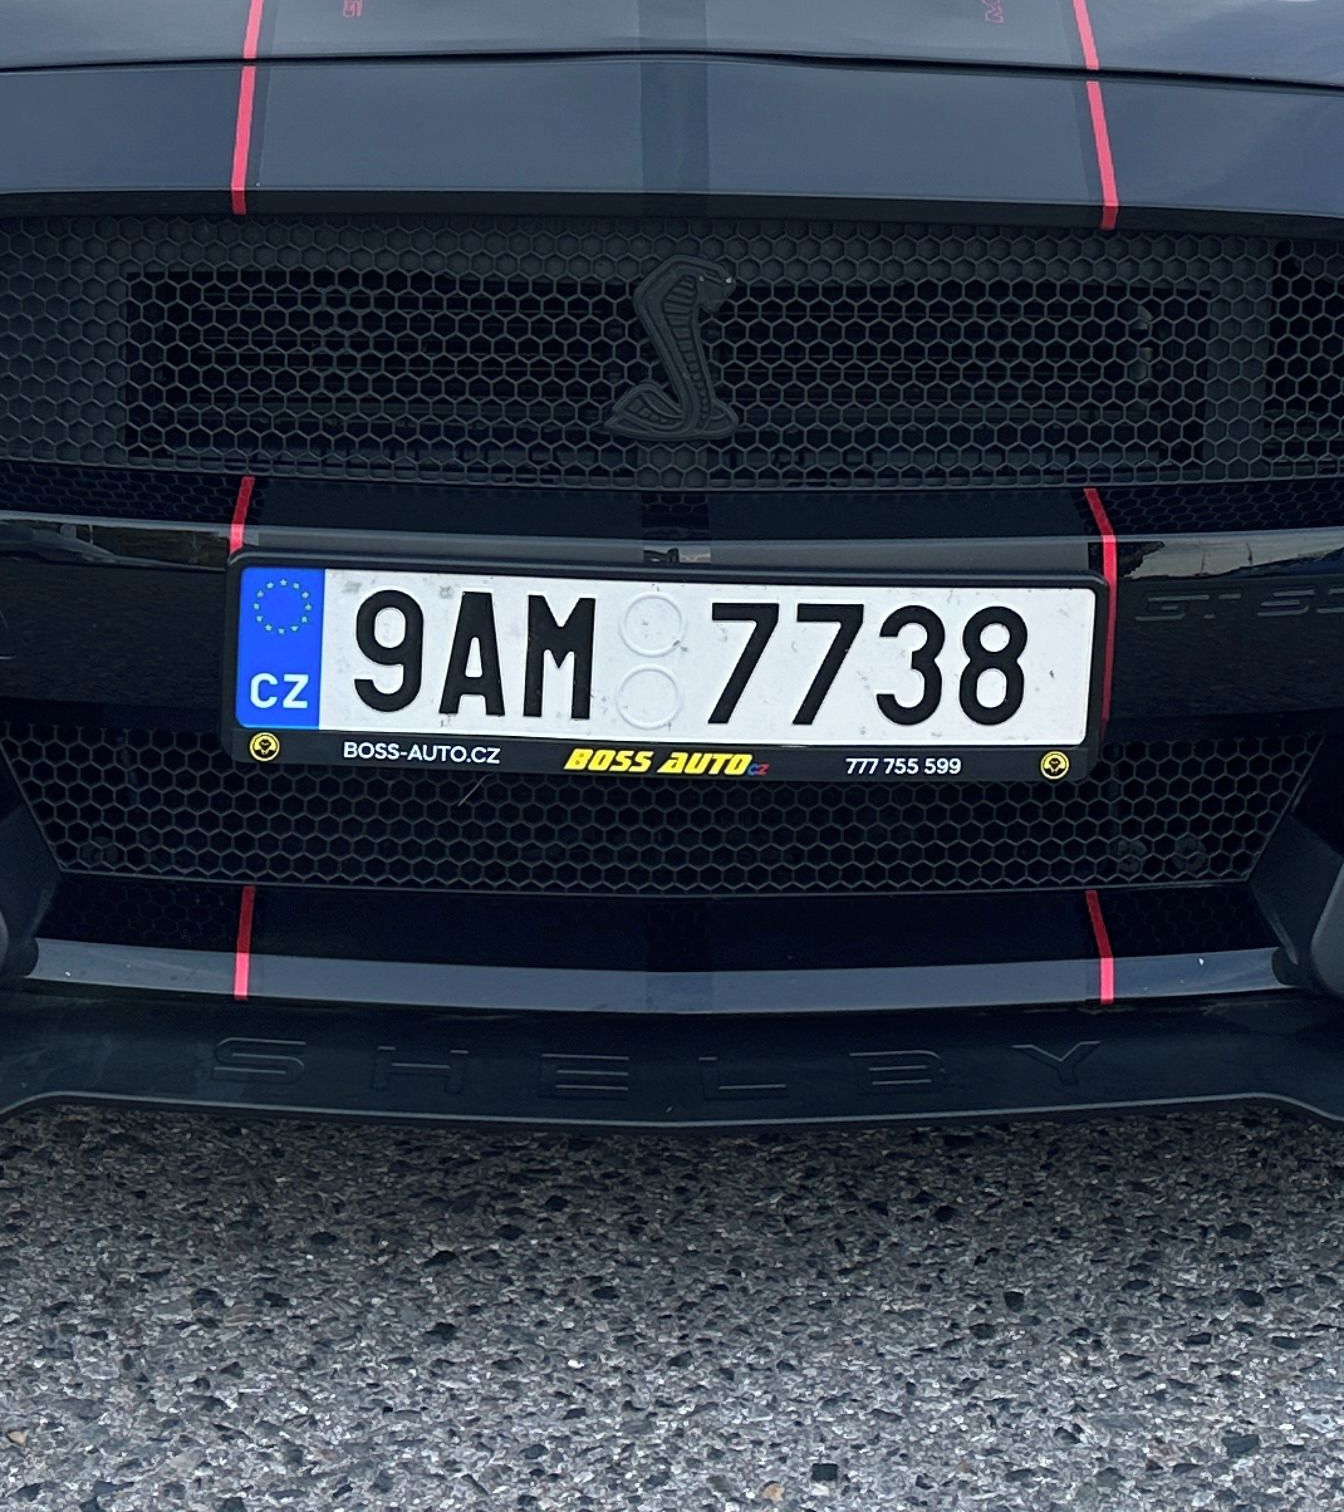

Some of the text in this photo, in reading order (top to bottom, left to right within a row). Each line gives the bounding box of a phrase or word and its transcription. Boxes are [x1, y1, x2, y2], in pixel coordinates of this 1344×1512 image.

[354, 589, 1029, 726] 9AM 7738
[250, 672, 309, 709] CZ
[343, 741, 501, 765] BOSS-AUTO.CZ
[564, 748, 653, 773] BOSS
[657, 753, 753, 776] AUTO
[846, 758, 961, 776] 777 755 599
[212, 1036, 1102, 1100] SHELBY
